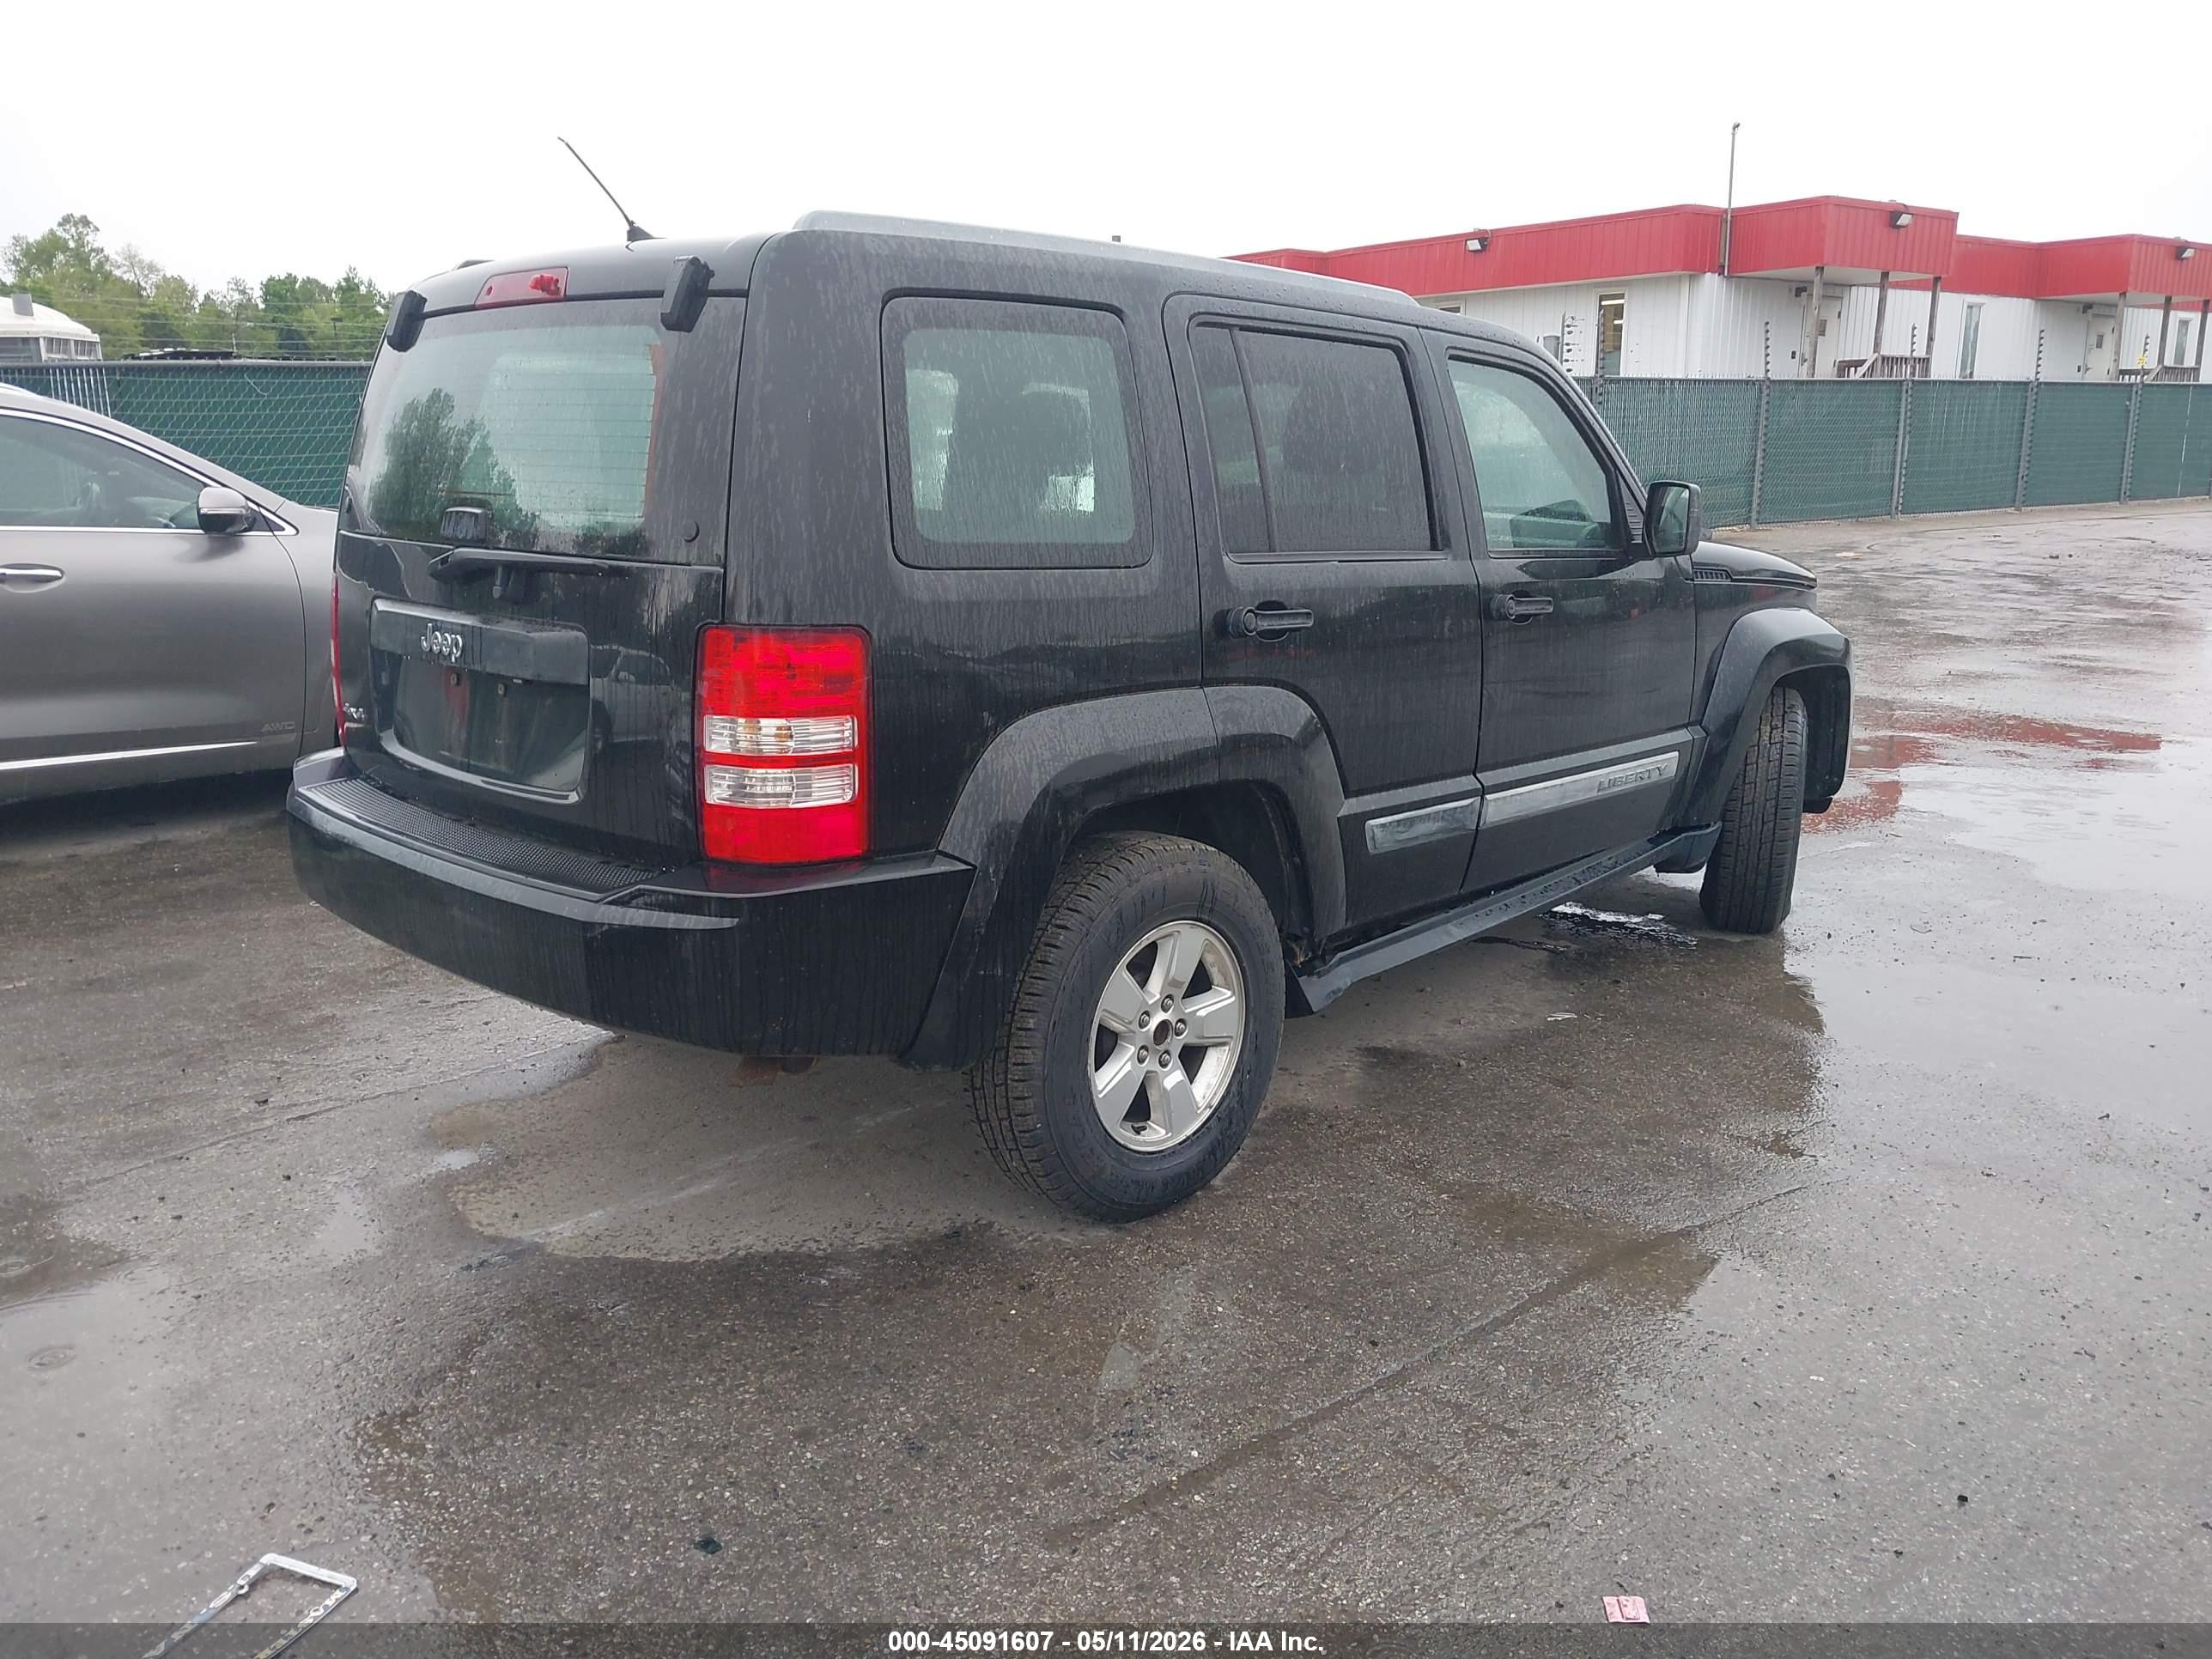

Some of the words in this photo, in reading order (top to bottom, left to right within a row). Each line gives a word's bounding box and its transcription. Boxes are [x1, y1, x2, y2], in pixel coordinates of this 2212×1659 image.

[421, 623, 463, 663] Jeep
[260, 721, 296, 732] AWD
[1596, 763, 1668, 793] LIBERTY
